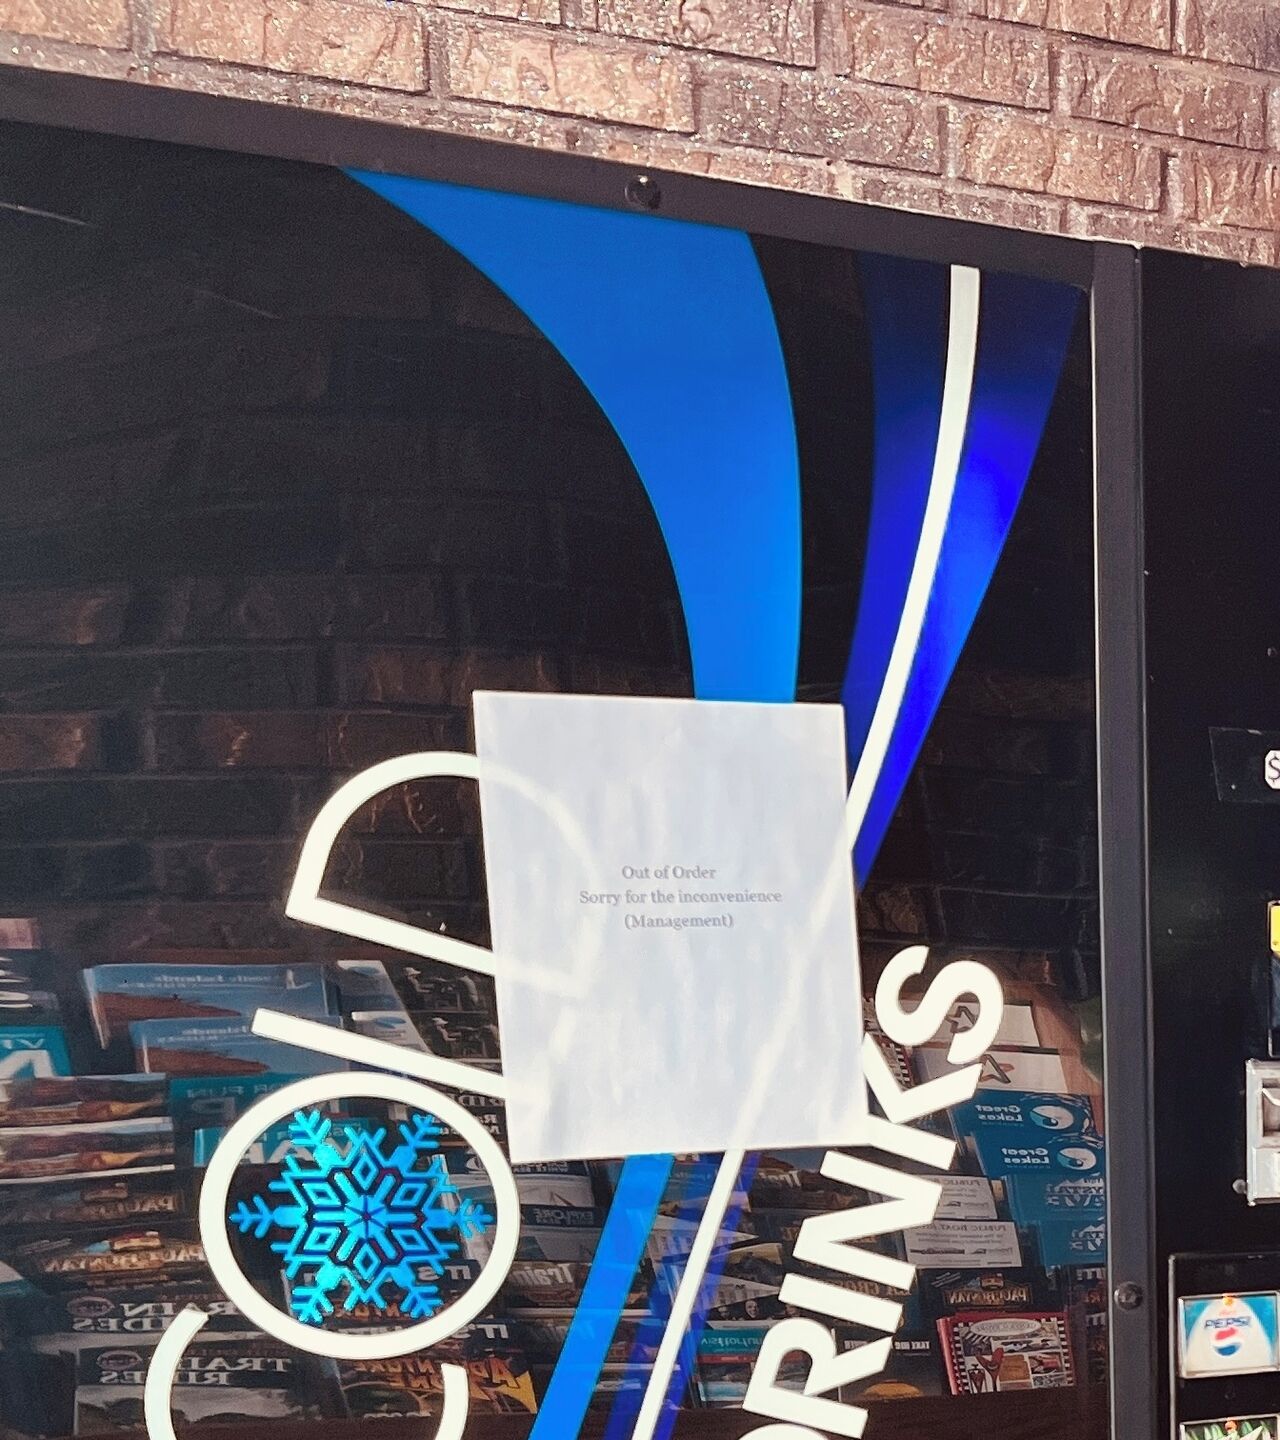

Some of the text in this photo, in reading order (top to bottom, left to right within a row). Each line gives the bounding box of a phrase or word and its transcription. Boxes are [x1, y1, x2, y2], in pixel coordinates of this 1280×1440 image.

[621, 865, 717, 880] Out of Order
[579, 889, 783, 907] Sorry for the inconvenience
[624, 913, 735, 931] (Management)
[1204, 1316, 1251, 1329] PEPSI
